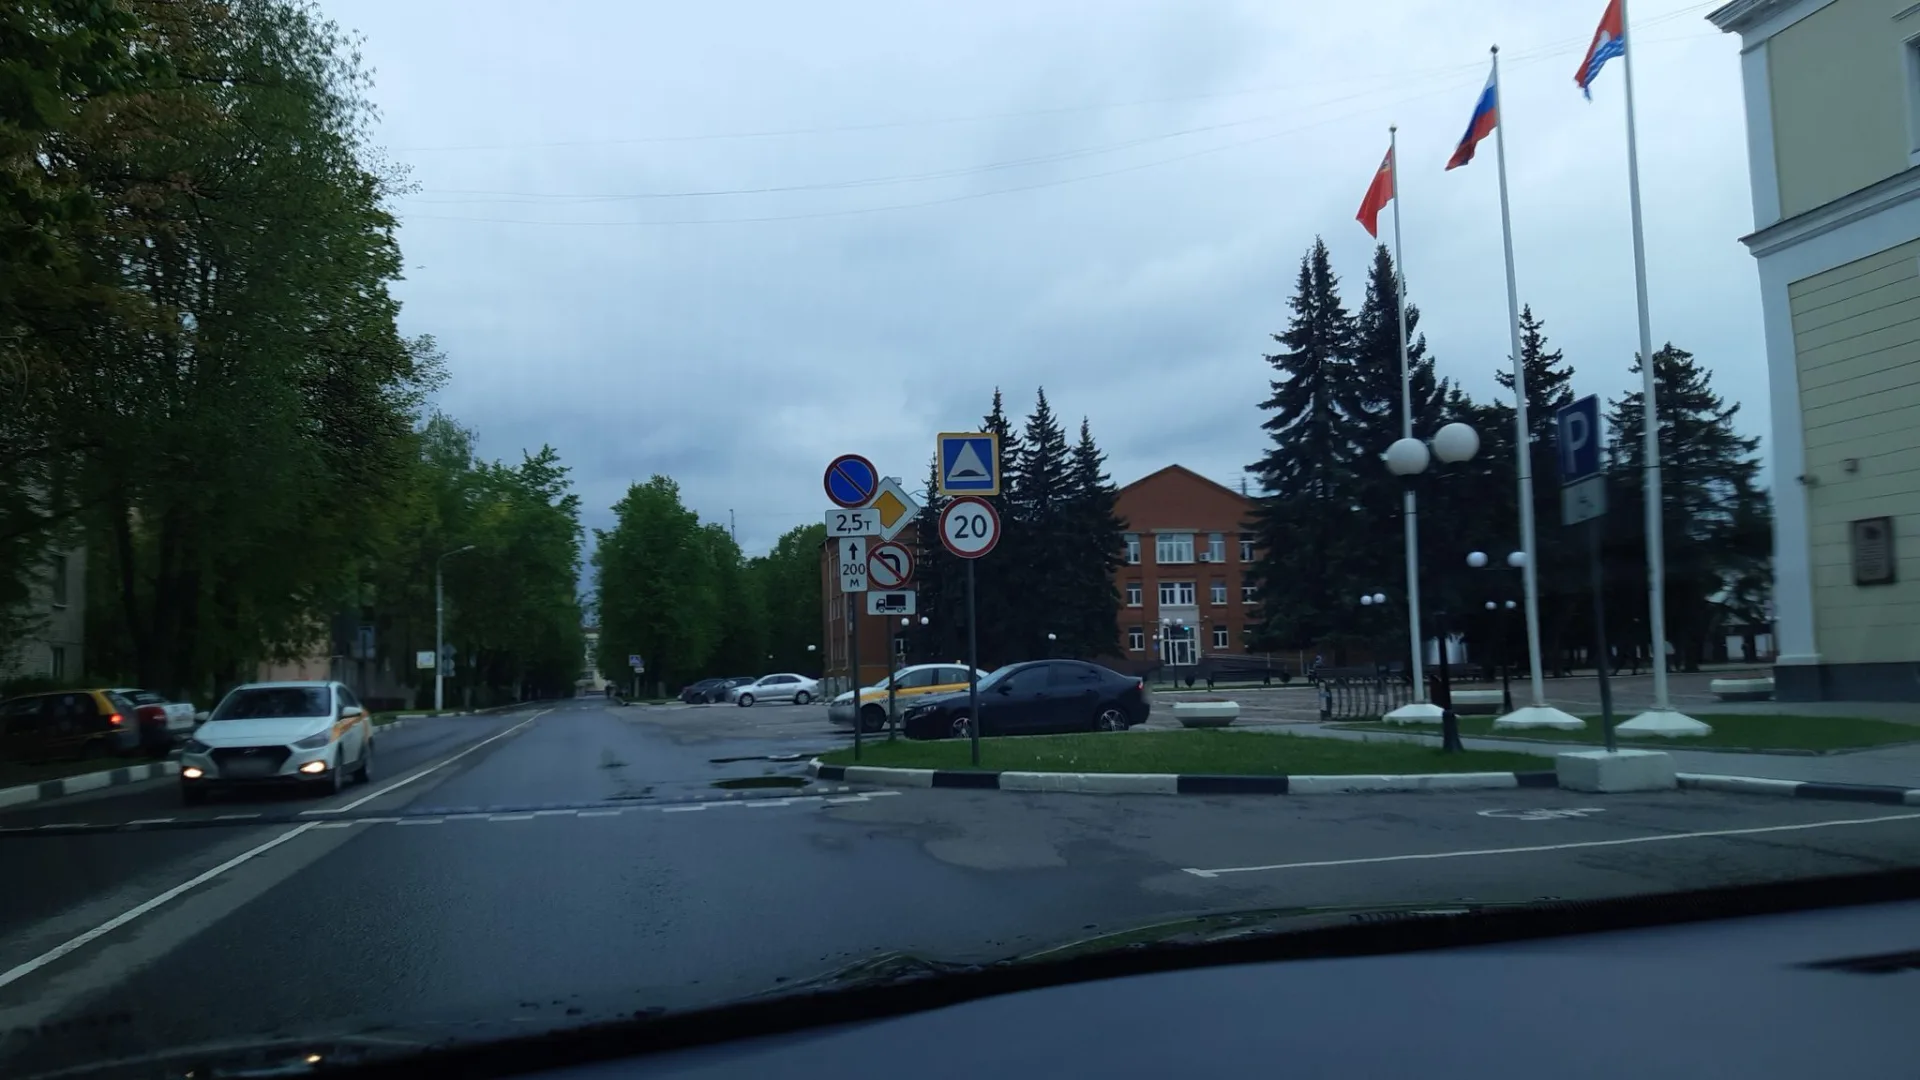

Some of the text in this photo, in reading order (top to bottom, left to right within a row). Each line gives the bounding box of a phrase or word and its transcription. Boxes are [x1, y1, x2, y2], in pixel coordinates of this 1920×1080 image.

[1565, 411, 1589, 474] P
[954, 514, 988, 539] 20
[842, 563, 866, 576] 200
